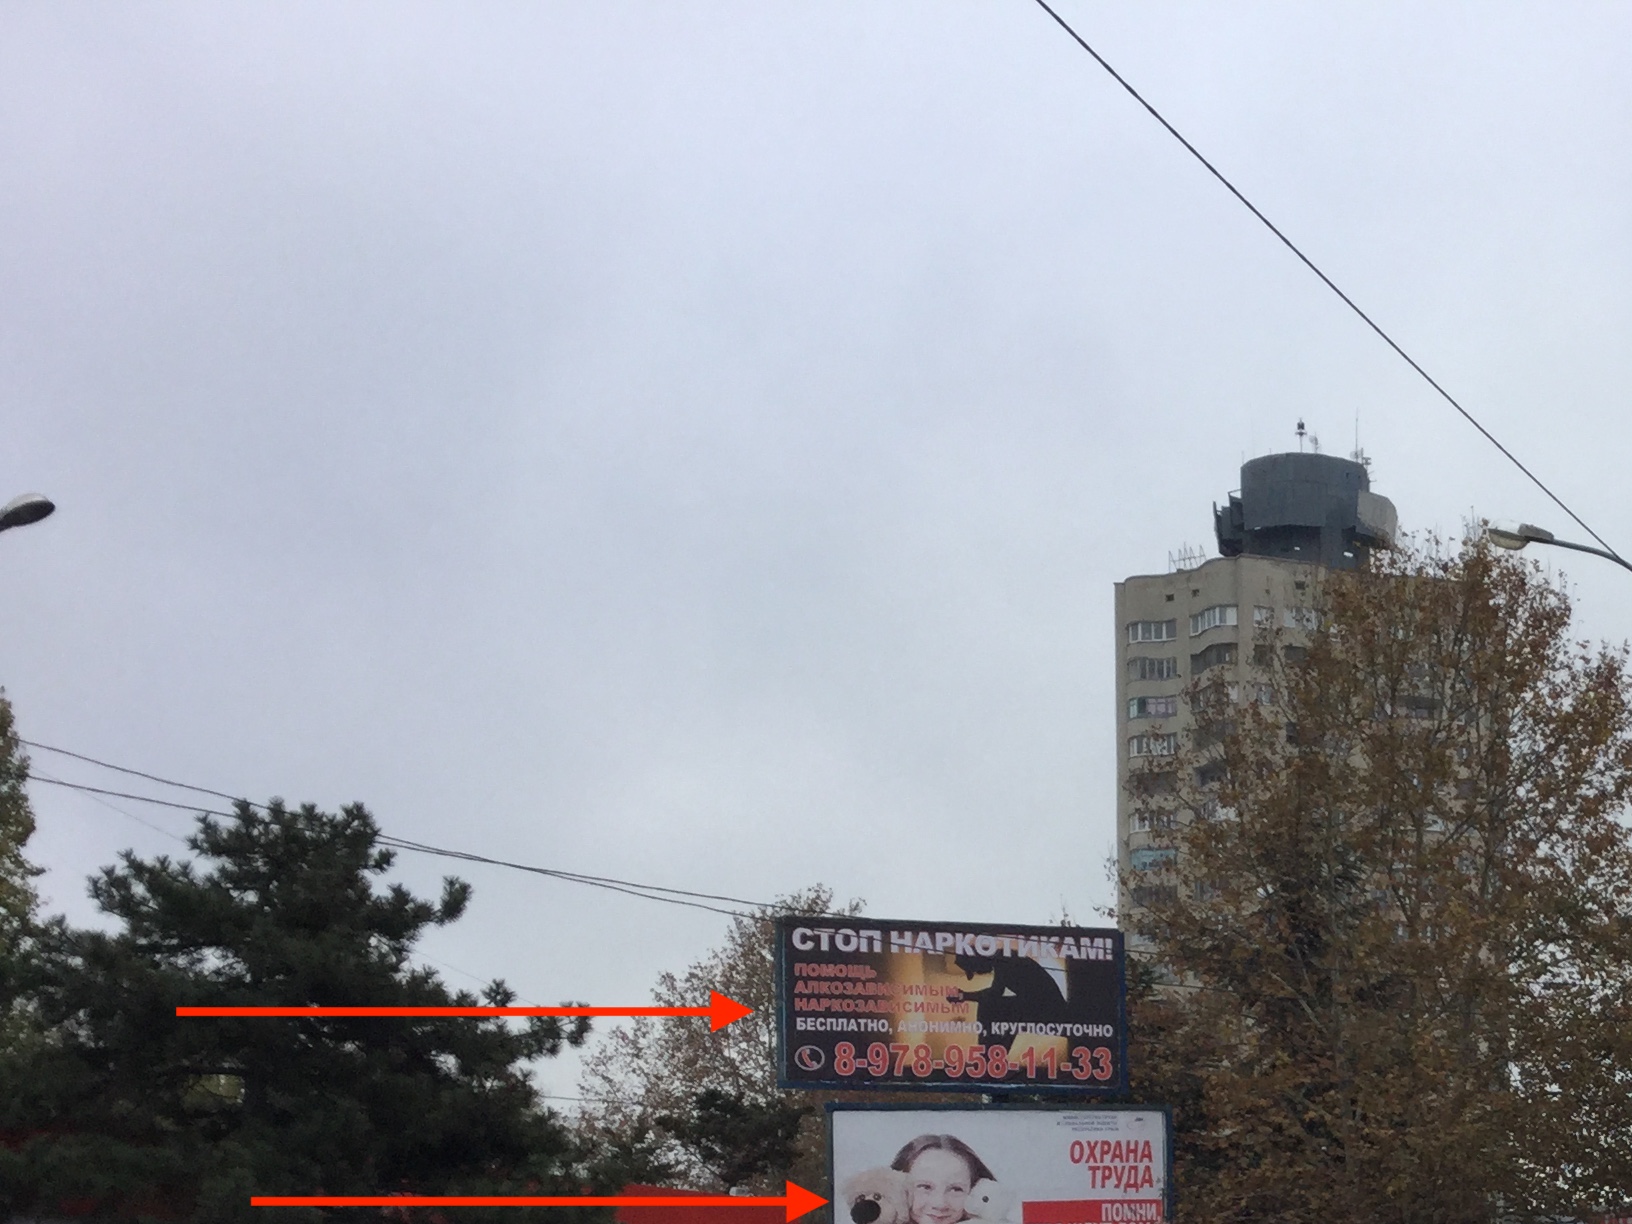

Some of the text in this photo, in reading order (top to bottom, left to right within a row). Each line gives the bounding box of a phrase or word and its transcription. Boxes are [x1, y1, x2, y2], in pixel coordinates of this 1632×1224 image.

[792, 927, 1113, 961] СТОП НАРКОТИКАМ!
[794, 963, 877, 980] ПОМОЩЬ
[794, 998, 969, 1014] НАРКОЗАВИСИМЫМ
[796, 1017, 1113, 1037] БЕСПЛАТНО, АНОНИМНО, КРУГЛОСУТОЧНО
[834, 1041, 1113, 1081] 8-978-958-11-33
[1069, 1140, 1153, 1164] ОХРАНА
[1088, 1165, 1154, 1193] ТРУДА
[1102, 1203, 1162, 1222] ПОМНИ,
